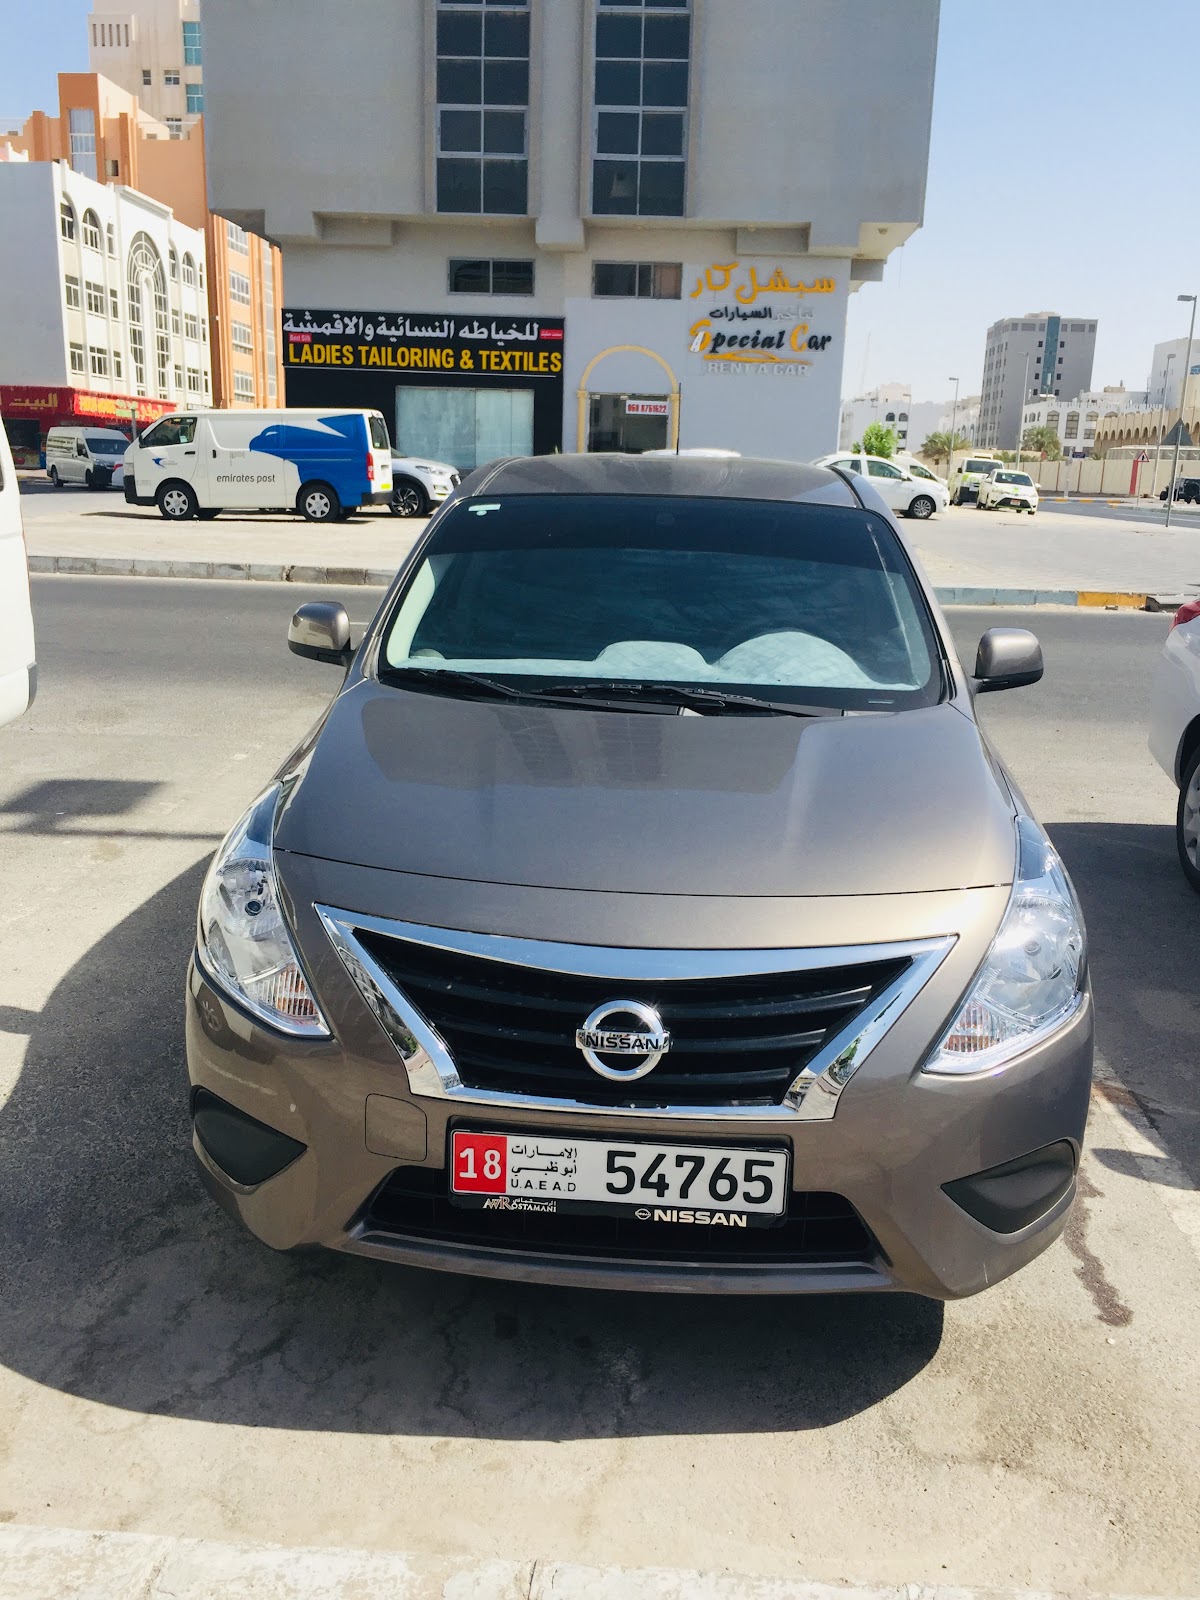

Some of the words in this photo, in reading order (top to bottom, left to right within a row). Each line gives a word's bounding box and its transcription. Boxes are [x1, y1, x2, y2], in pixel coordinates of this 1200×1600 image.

[690, 261, 739, 298] كار
[709, 306, 772, 321] السيارات
[688, 319, 786, 353] Special
[790, 323, 832, 352] Car
[288, 343, 354, 365] LADIES
[358, 345, 455, 369] TAILORING
[459, 349, 475, 370] &
[478, 350, 562, 372] TEXTILES
[707, 362, 754, 375] RENT
[756, 363, 769, 375] A
[773, 364, 810, 376] CAR
[216, 473, 254, 483] emirates
[256, 474, 276, 484] post
[585, 1034, 659, 1050] NISSAN
[458, 1147, 502, 1180] 18
[606, 1150, 775, 1204] 54765
[653, 1208, 747, 1228] NISSAN
